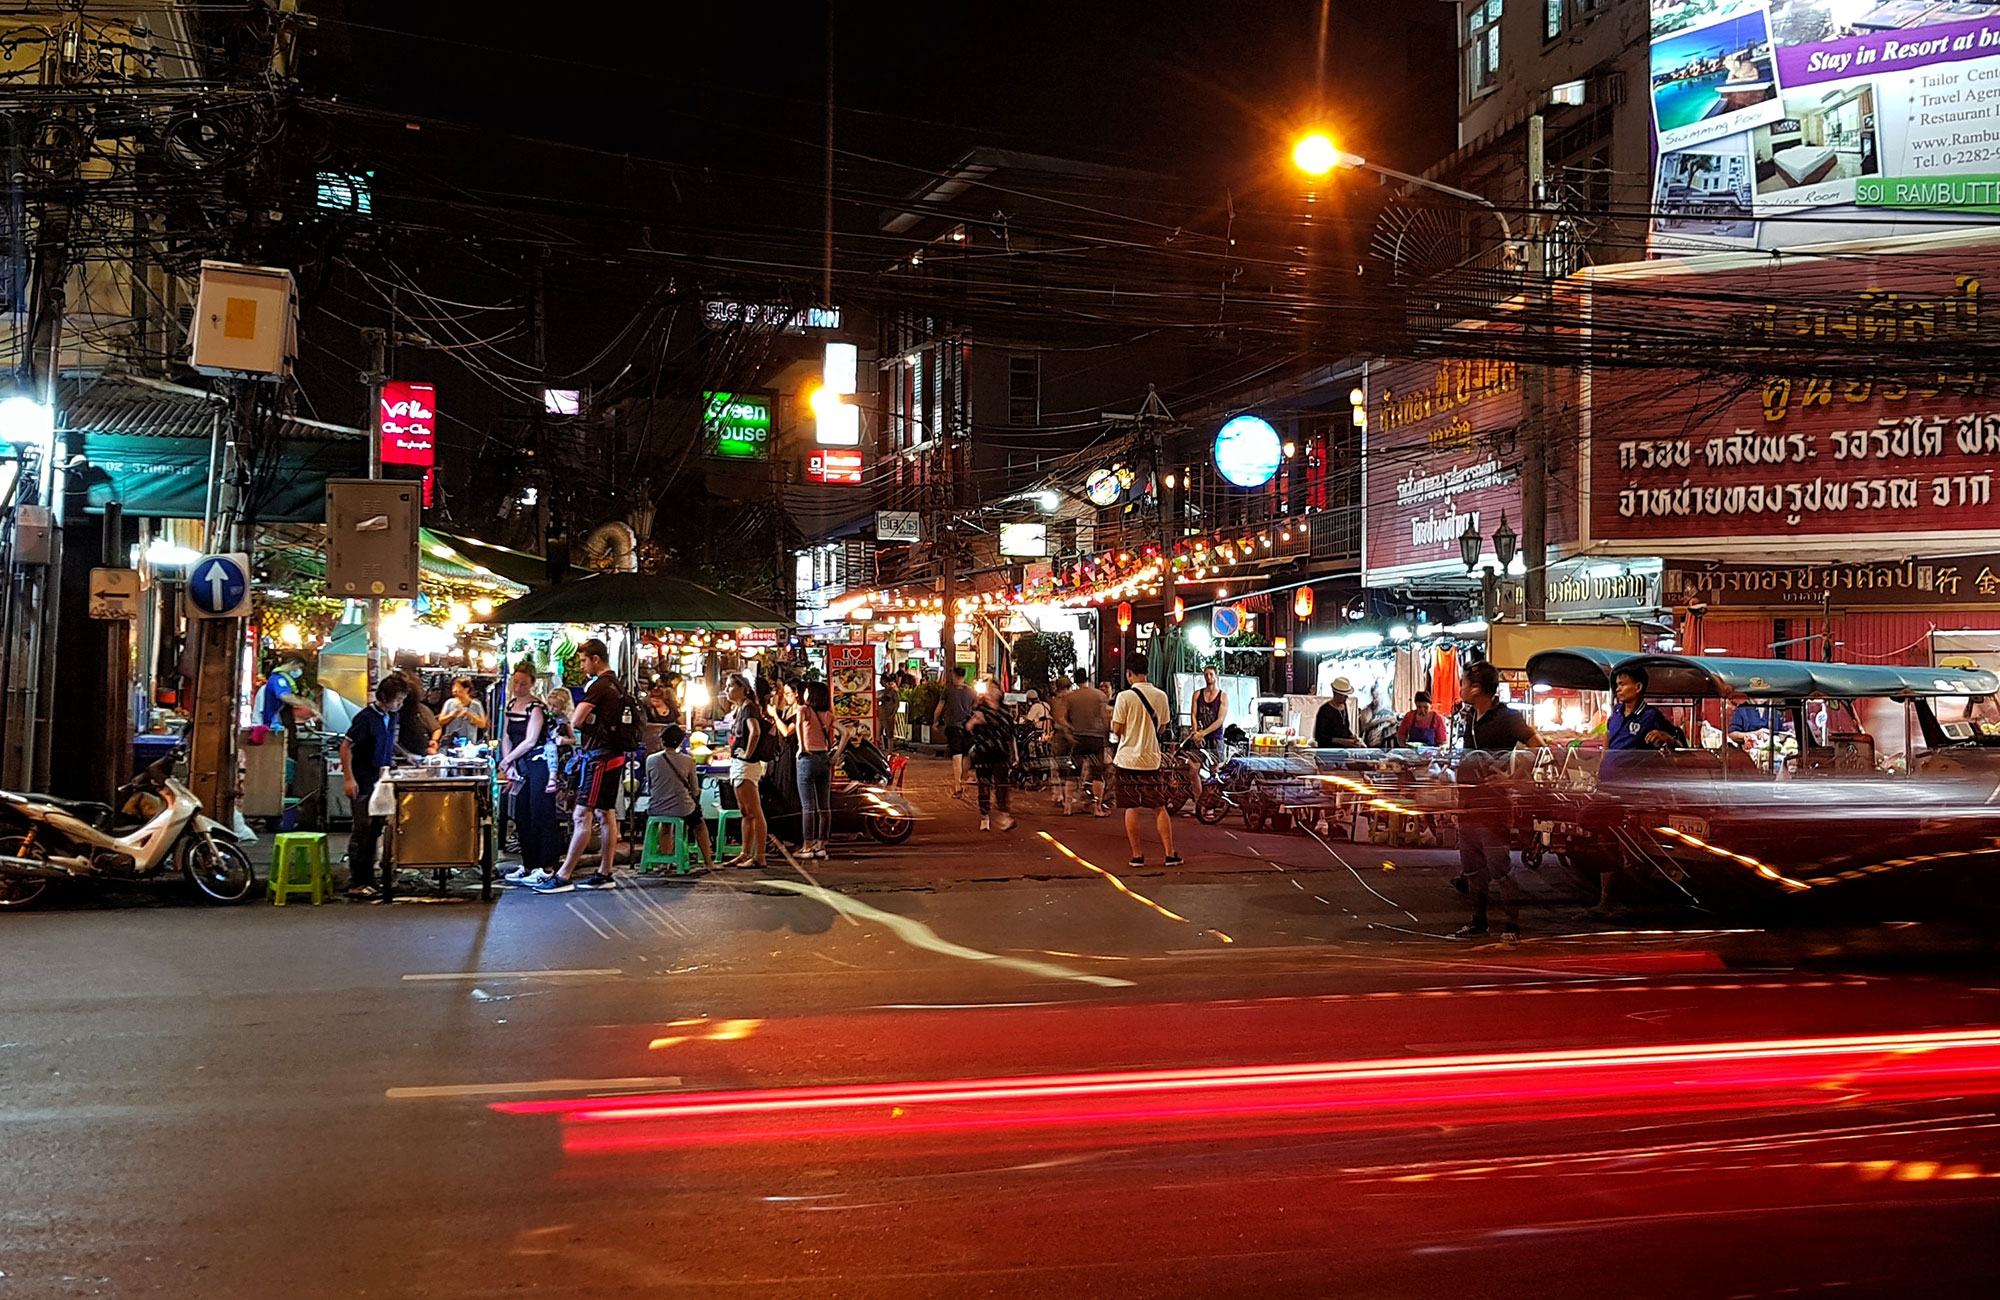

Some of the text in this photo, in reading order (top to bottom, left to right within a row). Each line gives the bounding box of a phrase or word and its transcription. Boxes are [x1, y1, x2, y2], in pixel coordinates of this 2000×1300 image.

[1807, 52, 1851, 73] Stay
[1856, 45, 1876, 65] in
[1881, 35, 1949, 62] Resort
[1953, 32, 1975, 50] at
[1920, 73, 1959, 88] Tailor
[1920, 90, 1960, 107] Travel
[1921, 106, 1990, 126] Restaurant
[1665, 110, 1763, 146] Swimming Pool
[1913, 155, 1939, 169] Tel.
[1805, 190, 1840, 203] Room
[1857, 184, 1885, 203] SOI
[706, 398, 767, 421] Green
[1931, 472, 1992, 507] จาก
[852, 657, 872, 666] Food
